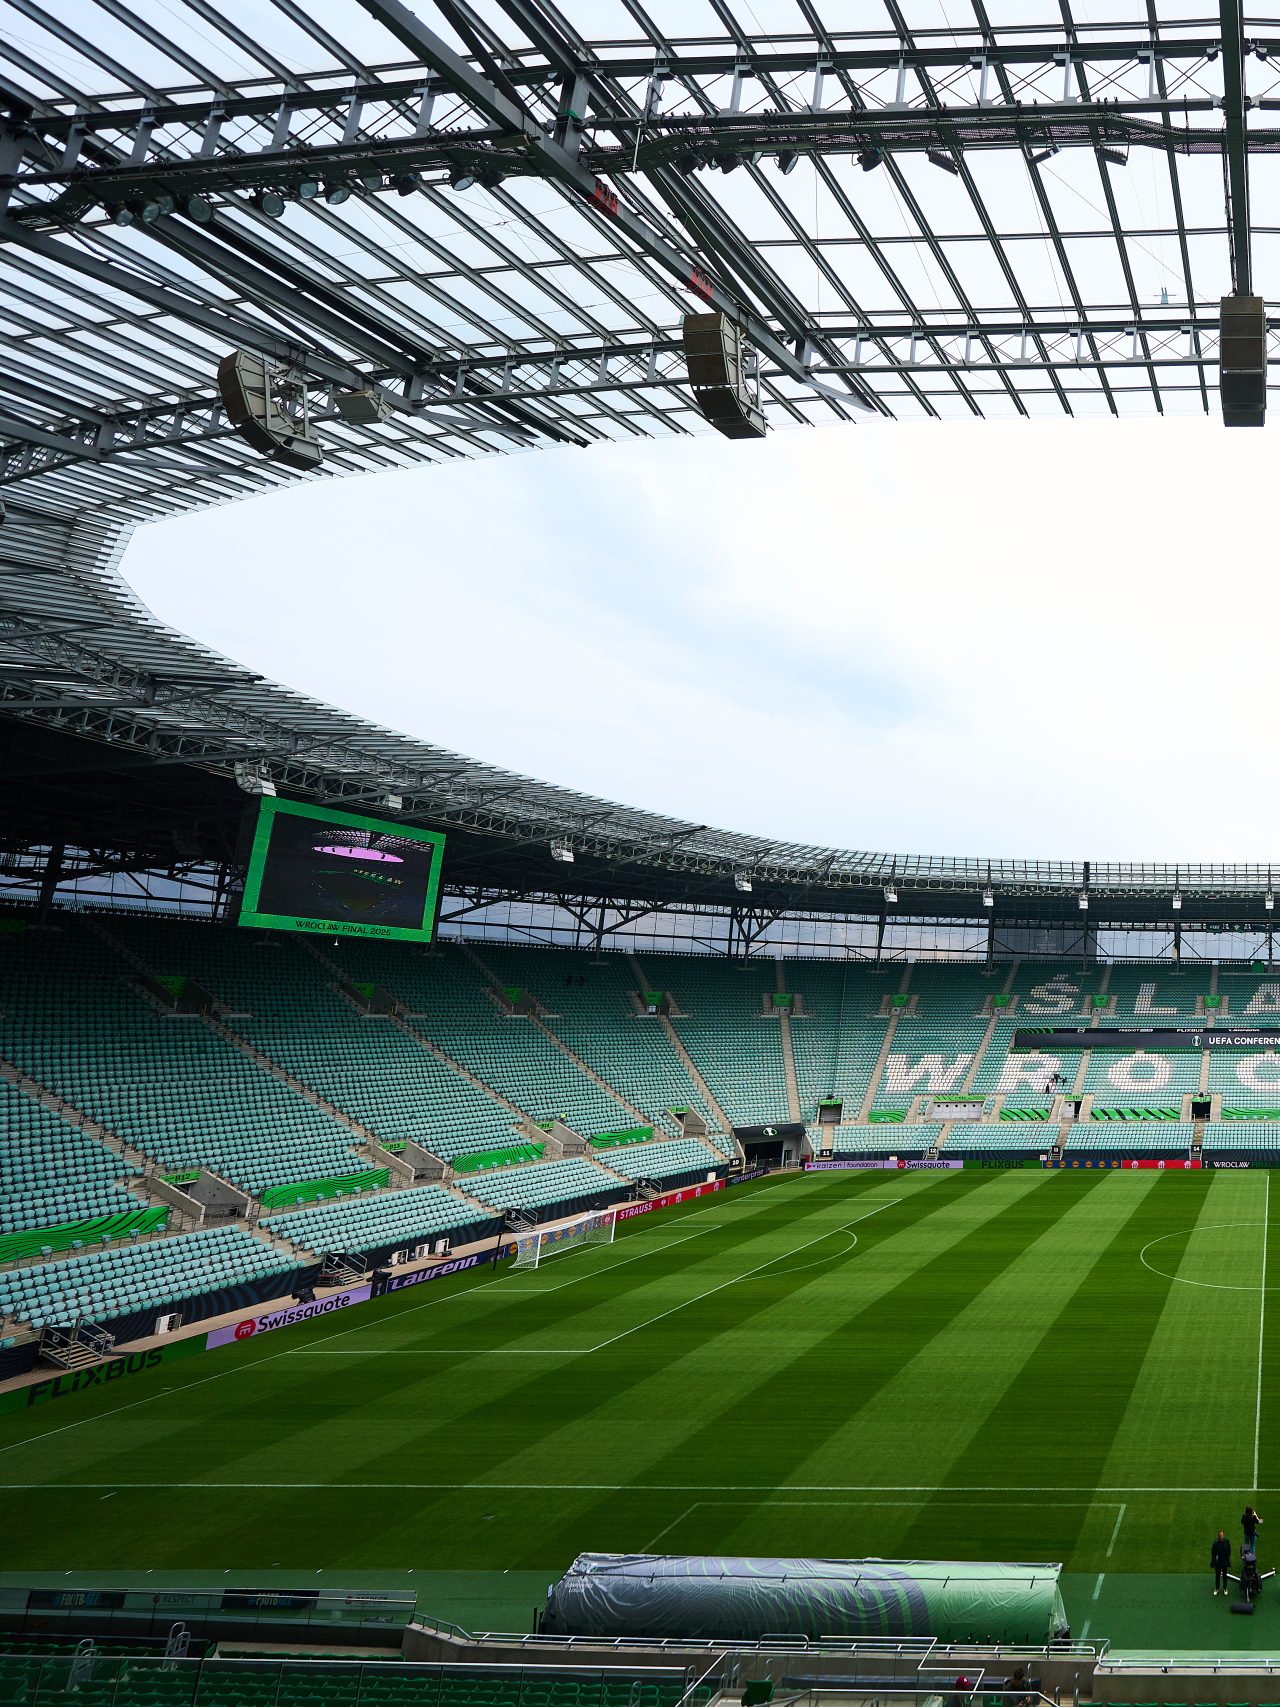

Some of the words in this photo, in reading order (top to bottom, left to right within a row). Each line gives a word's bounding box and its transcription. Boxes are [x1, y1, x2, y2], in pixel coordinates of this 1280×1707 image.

[342, 925, 368, 934] FINAL
[370, 927, 392, 936] 2025
[1208, 1037, 1232, 1045] UEFA
[906, 1160, 950, 1169] Swissquote
[174, 1173, 191, 1182] B12
[619, 1202, 653, 1221] STRAUSS
[258, 1294, 350, 1333] Swissquote
[52, 1332, 59, 1343] 6
[162, 1594, 195, 1604] RESPECT
